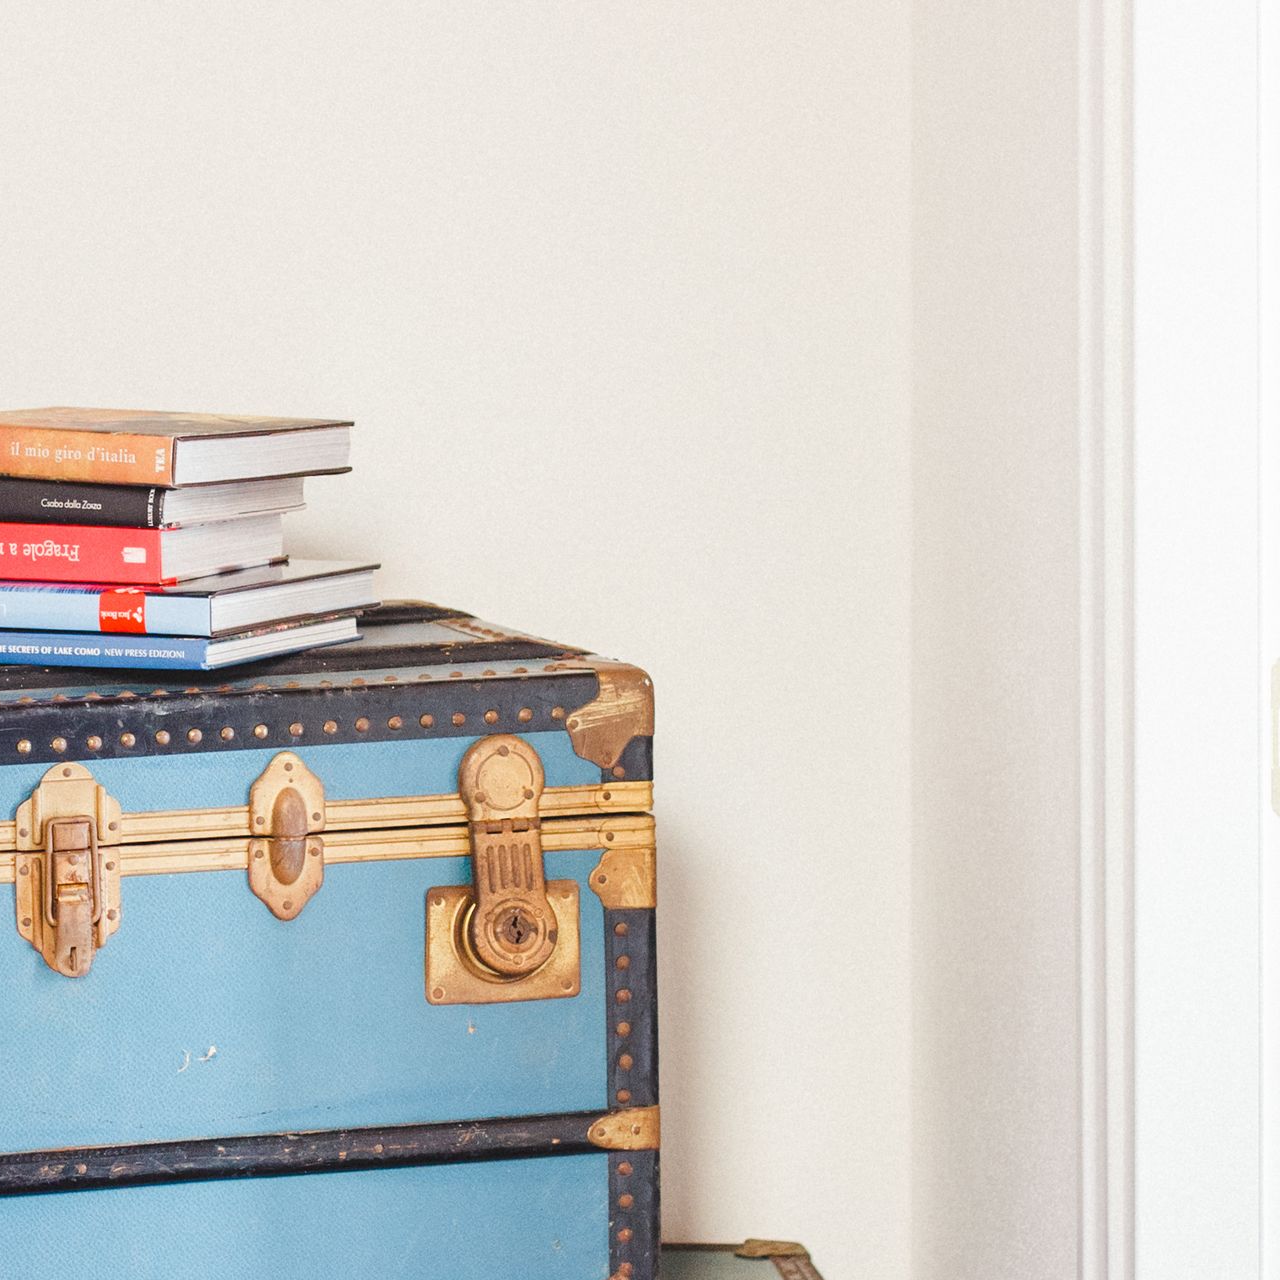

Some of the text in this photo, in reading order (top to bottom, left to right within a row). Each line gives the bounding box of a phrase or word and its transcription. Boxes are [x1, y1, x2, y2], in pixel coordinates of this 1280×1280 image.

[11, 441, 21, 456] il
[24, 444, 50, 458] mio
[54, 445, 82, 464] giro
[87, 446, 137, 464] d'italia
[154, 448, 166, 473] TEA
[40, 498, 64, 509] Csaba
[64, 499, 82, 509] dalla
[8, 542, 18, 555] a
[23, 539, 80, 562] Fragole
[100, 611, 118, 620] Book
[7, 644, 39, 654] SECRETS
[40, 645, 52, 654] OF
[53, 646, 73, 656] LAKE
[74, 647, 100, 656] COMO
[103, 648, 124, 657] NEW
[124, 648, 147, 658] PRESS
[148, 649, 185, 659] EDIZIONI
